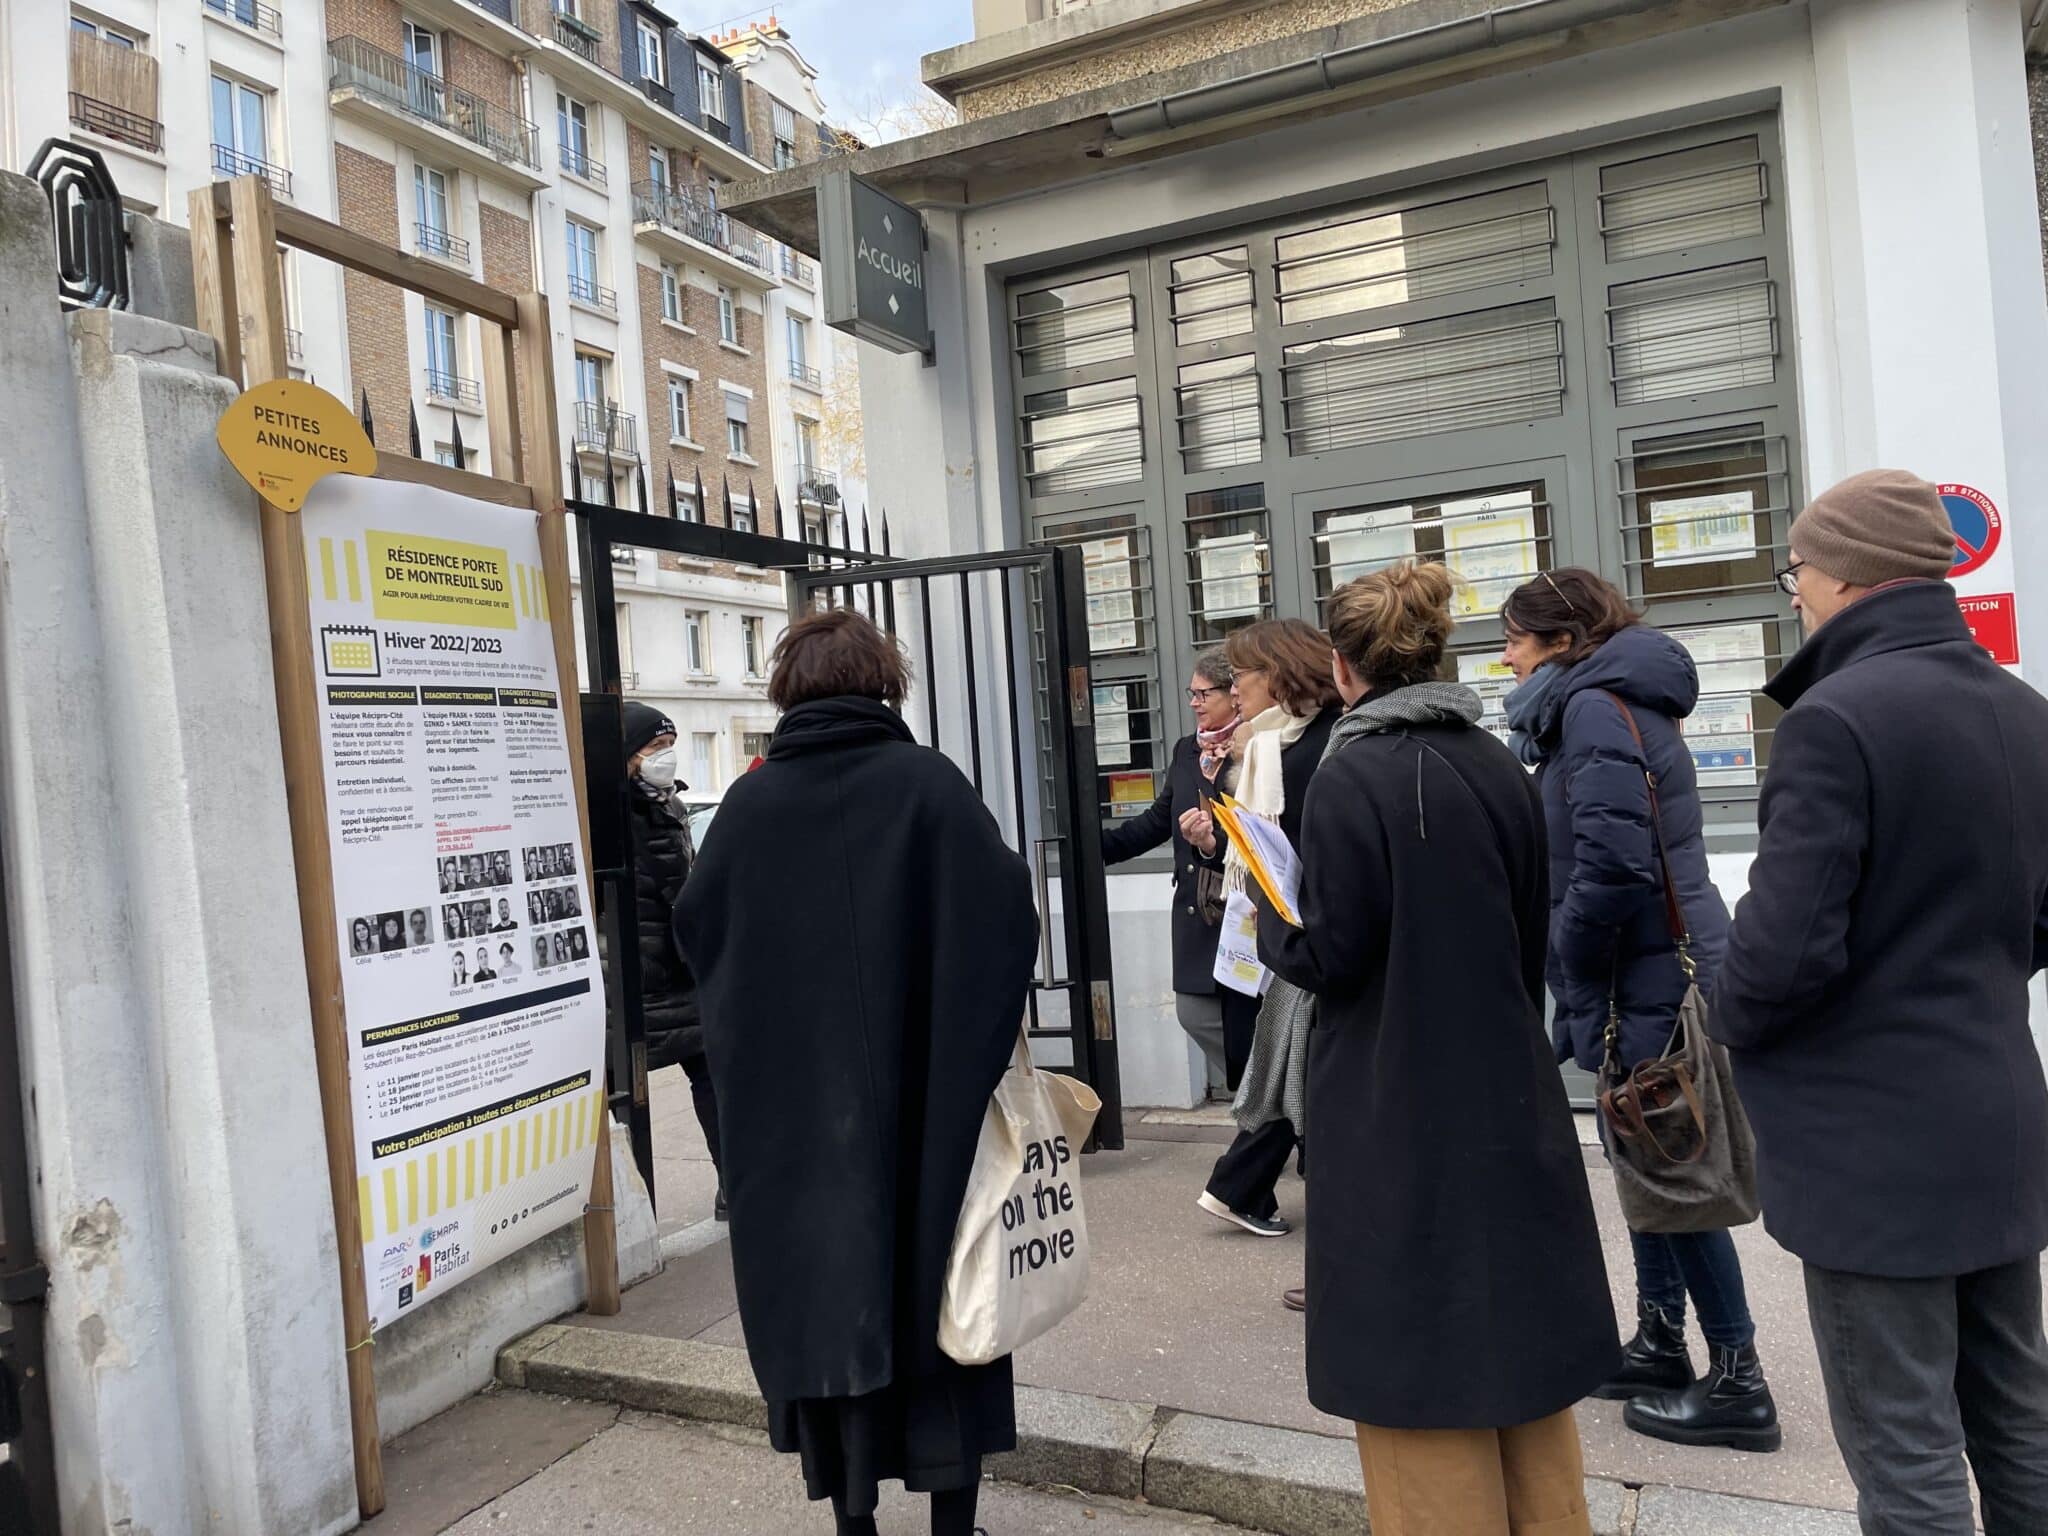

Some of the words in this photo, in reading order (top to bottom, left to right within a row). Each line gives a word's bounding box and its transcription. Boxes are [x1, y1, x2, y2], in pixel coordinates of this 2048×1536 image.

[858, 236, 922, 288] Accueil
[254, 405, 320, 435] PETITES
[256, 430, 348, 463] ANNONCES
[1944, 486, 1956, 494] DE
[1960, 488, 1999, 529] STATIONNER
[1477, 513, 1497, 522] PARIS
[387, 545, 460, 570] RÉSIDENCE
[461, 558, 499, 575] PORTE
[385, 566, 404, 581] DE
[407, 569, 480, 590] MONTREUIL
[481, 578, 504, 593] SUD
[382, 590, 400, 599] AGIR
[400, 591, 420, 601] POUR
[420, 593, 455, 604] AMÉLIORER
[455, 597, 474, 606] VOTRE
[474, 599, 493, 608] CADRE
[493, 601, 501, 609] DE
[1959, 600, 2000, 613] CTION
[384, 631, 427, 650] Hiver
[429, 634, 502, 656] 2022/2023
[396, 668, 432, 678] programme
[414, 659, 428, 668] sont
[330, 691, 386, 699] PHOTOGRAPHIE
[388, 691, 416, 699] SOCIALE
[424, 692, 462, 700] DIAGNOSTIC
[463, 692, 494, 701] TECHNIQUE
[500, 688, 530, 697] DIAGNOSTIC
[330, 712, 360, 720] L'équipe
[362, 712, 404, 720] Récipro-Cité
[423, 712, 448, 720] L'équipe
[426, 738, 442, 746] point
[336, 760, 366, 768] parcours
[338, 788, 374, 797] confidentiel
[341, 818, 360, 826] appel
[362, 815, 407, 824] téléphonique
[342, 826, 390, 836] porte-à-porte
[366, 1022, 420, 1041] PERMANENCES
[420, 1013, 460, 1029] LOCATAIRES
[363, 1053, 374, 1061] Les
[376, 1048, 400, 1058] équipes
[402, 1043, 418, 1052] Paris
[420, 1036, 442, 1048] Habitat
[364, 1058, 393, 1071] Schubert
[488, 1030, 498, 1039] 14h
[503, 1024, 520, 1035] 17h30
[376, 1080, 386, 1088] Le
[387, 1077, 396, 1086] 11
[398, 1072, 420, 1084] janvier
[422, 1068, 434, 1077] pour
[398, 1082, 421, 1095] janvier
[422, 1078, 435, 1088] pour
[379, 1100, 388, 1108] Le
[388, 1096, 398, 1106] 25
[400, 1091, 422, 1104] janvier
[380, 1110, 389, 1118] Le
[390, 1108, 402, 1116] 1er
[402, 1100, 424, 1112] février
[376, 1140, 406, 1157] Votre
[408, 1120, 465, 1149] participation
[466, 1115, 472, 1127] à
[473, 1108, 500, 1124] toutes
[500, 1104, 513, 1115] ces
[514, 1095, 540, 1110] étapes
[540, 1090, 551, 1101] est
[552, 1076, 588, 1096] essentielle
[1022, 1135, 1071, 1178] ays
[1002, 1194, 1026, 1232] on
[1032, 1178, 1074, 1220] the
[428, 1220, 459, 1242] SEMAPA
[434, 1242, 460, 1265] Paris
[1009, 1228, 1074, 1280] move
[401, 1264, 414, 1280] 20
[434, 1250, 470, 1280] Habitat
